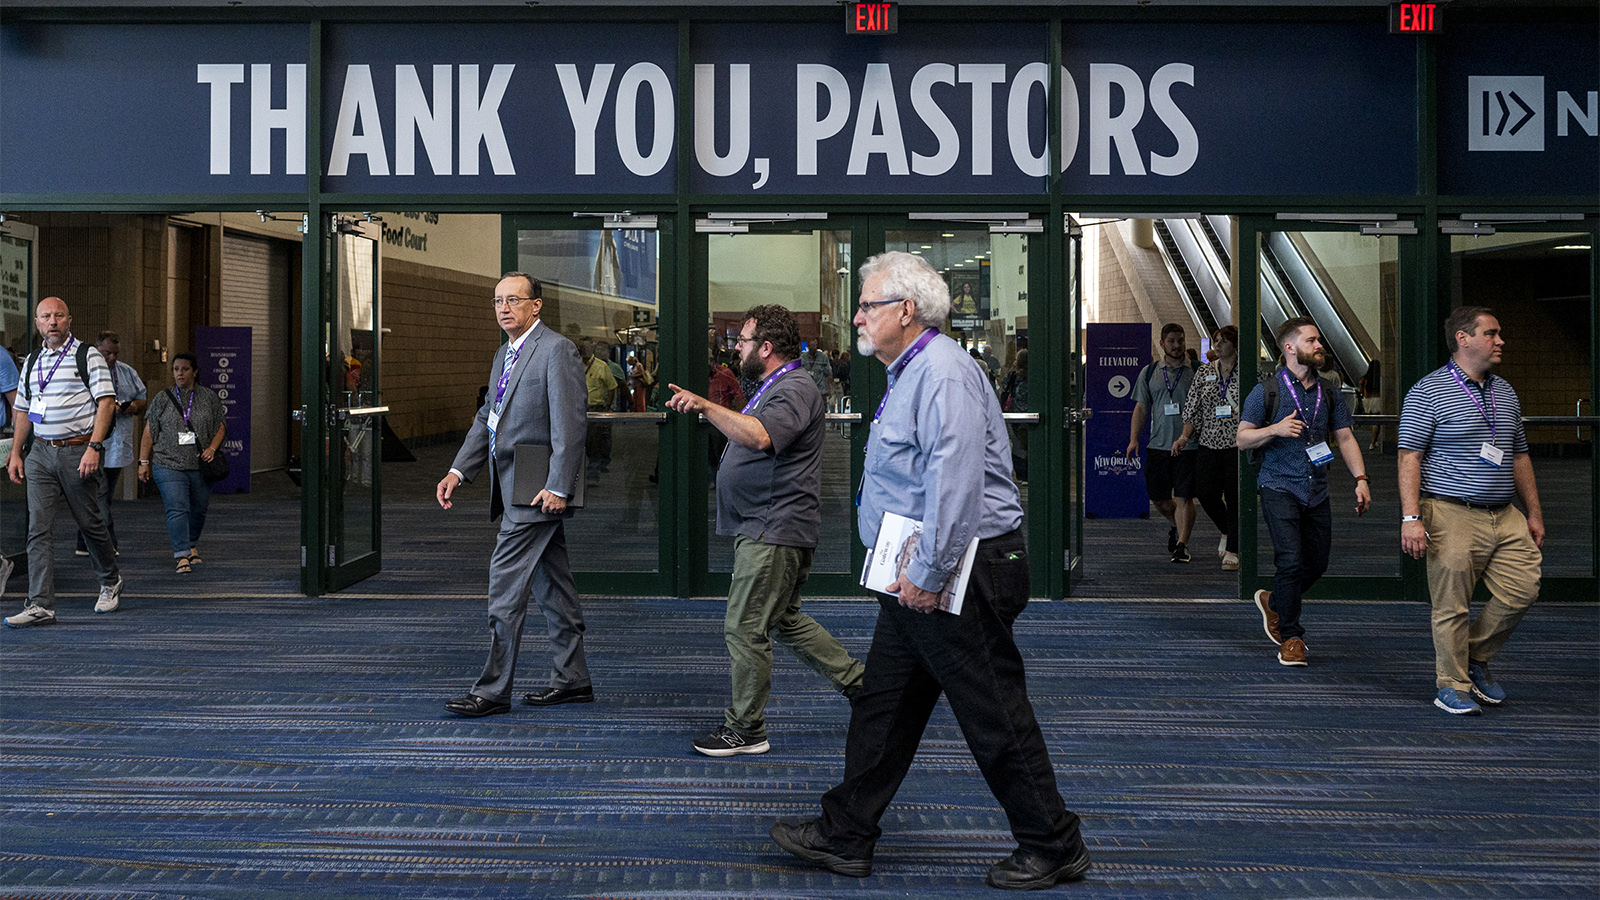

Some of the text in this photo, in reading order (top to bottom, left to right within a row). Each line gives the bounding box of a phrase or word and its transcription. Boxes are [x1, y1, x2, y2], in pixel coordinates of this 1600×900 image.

[855, 4, 891, 31] EXIT
[1399, 4, 1436, 31] EXIT
[196, 61, 1199, 190] THANK YOU, PASTORS
[381, 221, 428, 252] Food Court
[1099, 356, 1139, 367] ELEVATOR
[1094, 454, 1110, 471] NEW
